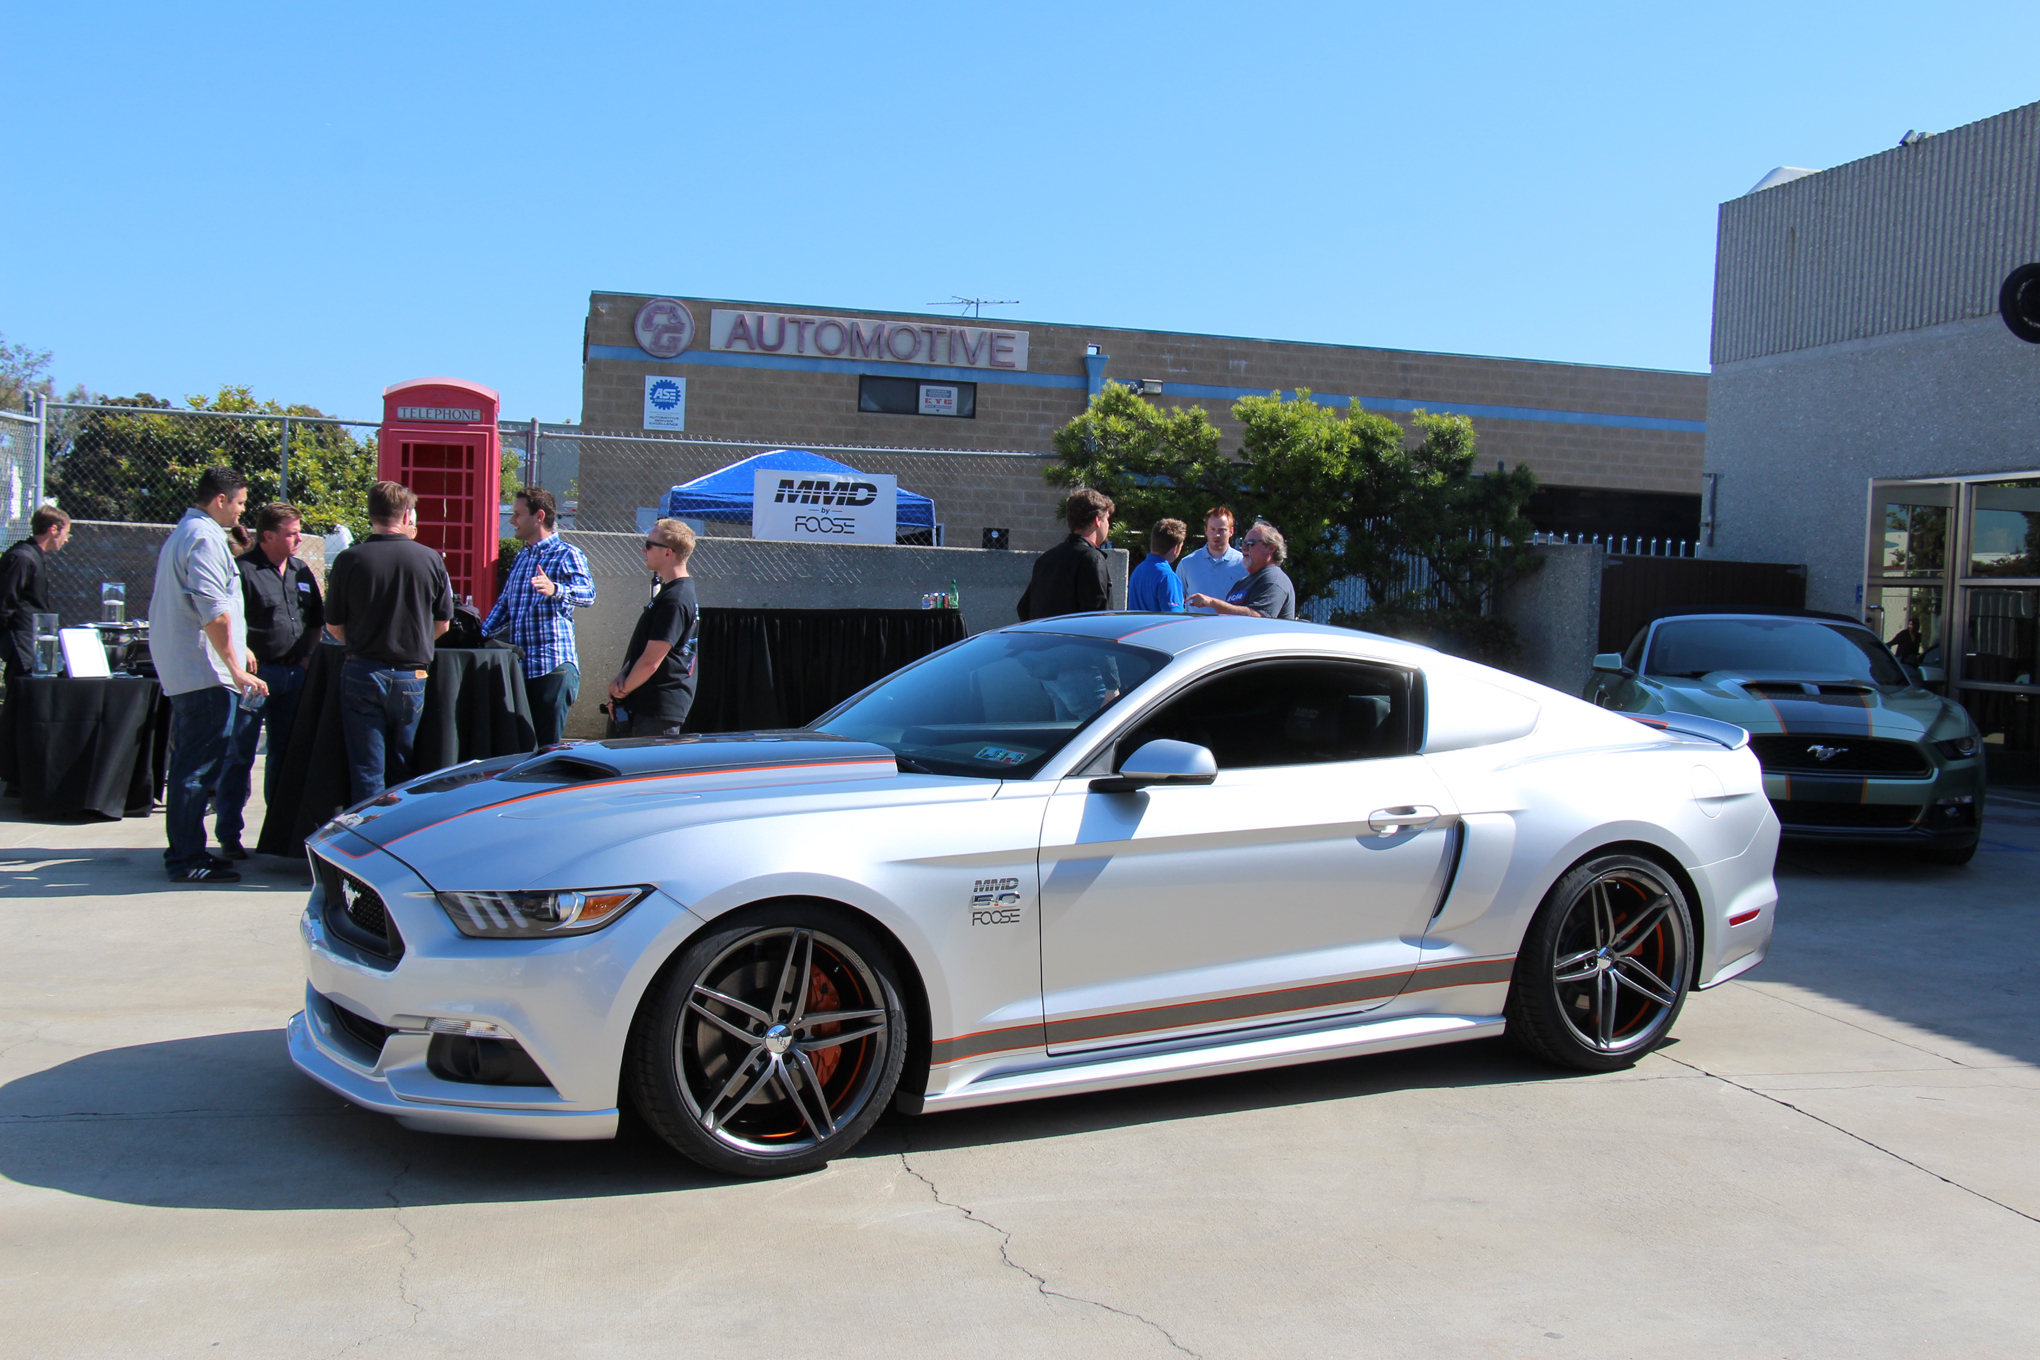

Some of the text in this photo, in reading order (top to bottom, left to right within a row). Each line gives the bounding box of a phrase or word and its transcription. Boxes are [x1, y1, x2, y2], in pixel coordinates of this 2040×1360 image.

[725, 313, 1017, 368] AUTOMOTIVE
[653, 388, 677, 400] ASE
[401, 407, 478, 421] TELEPHONE
[774, 479, 878, 507] MMD
[821, 507, 831, 515] by
[795, 516, 855, 534] FOOSE
[973, 877, 1019, 893] MMD
[971, 891, 1021, 910] 5.0
[972, 909, 1020, 926] FOOSE
